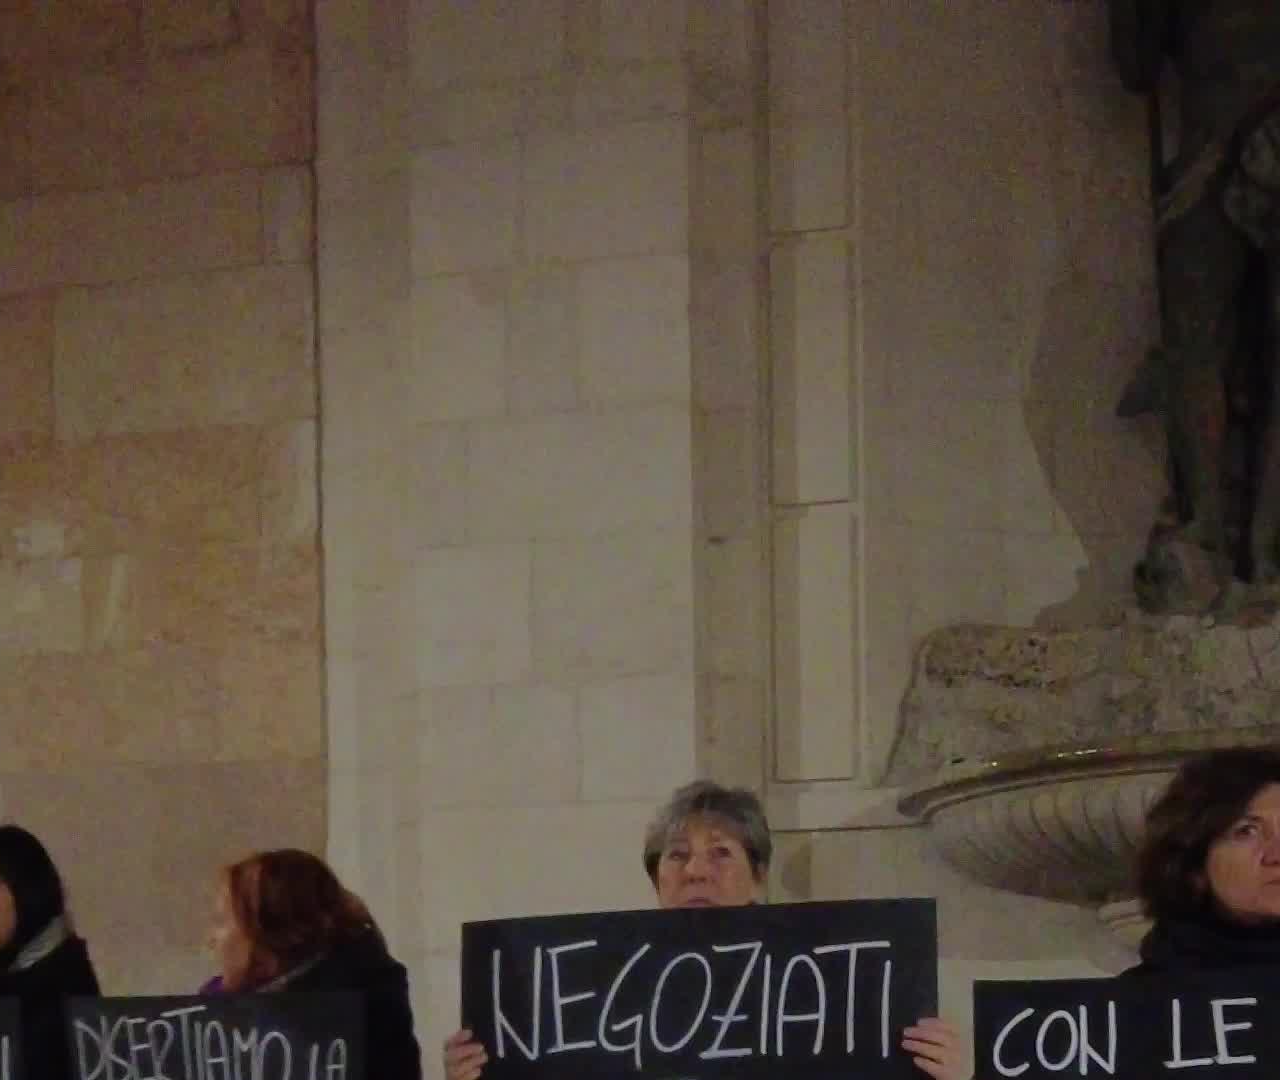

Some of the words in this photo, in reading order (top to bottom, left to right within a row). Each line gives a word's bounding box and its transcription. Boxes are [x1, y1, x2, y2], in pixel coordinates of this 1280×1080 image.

[493, 940, 891, 1070] NEGOZIATI
[993, 1000, 1116, 1076] CON
[1164, 997, 1257, 1069] LE
